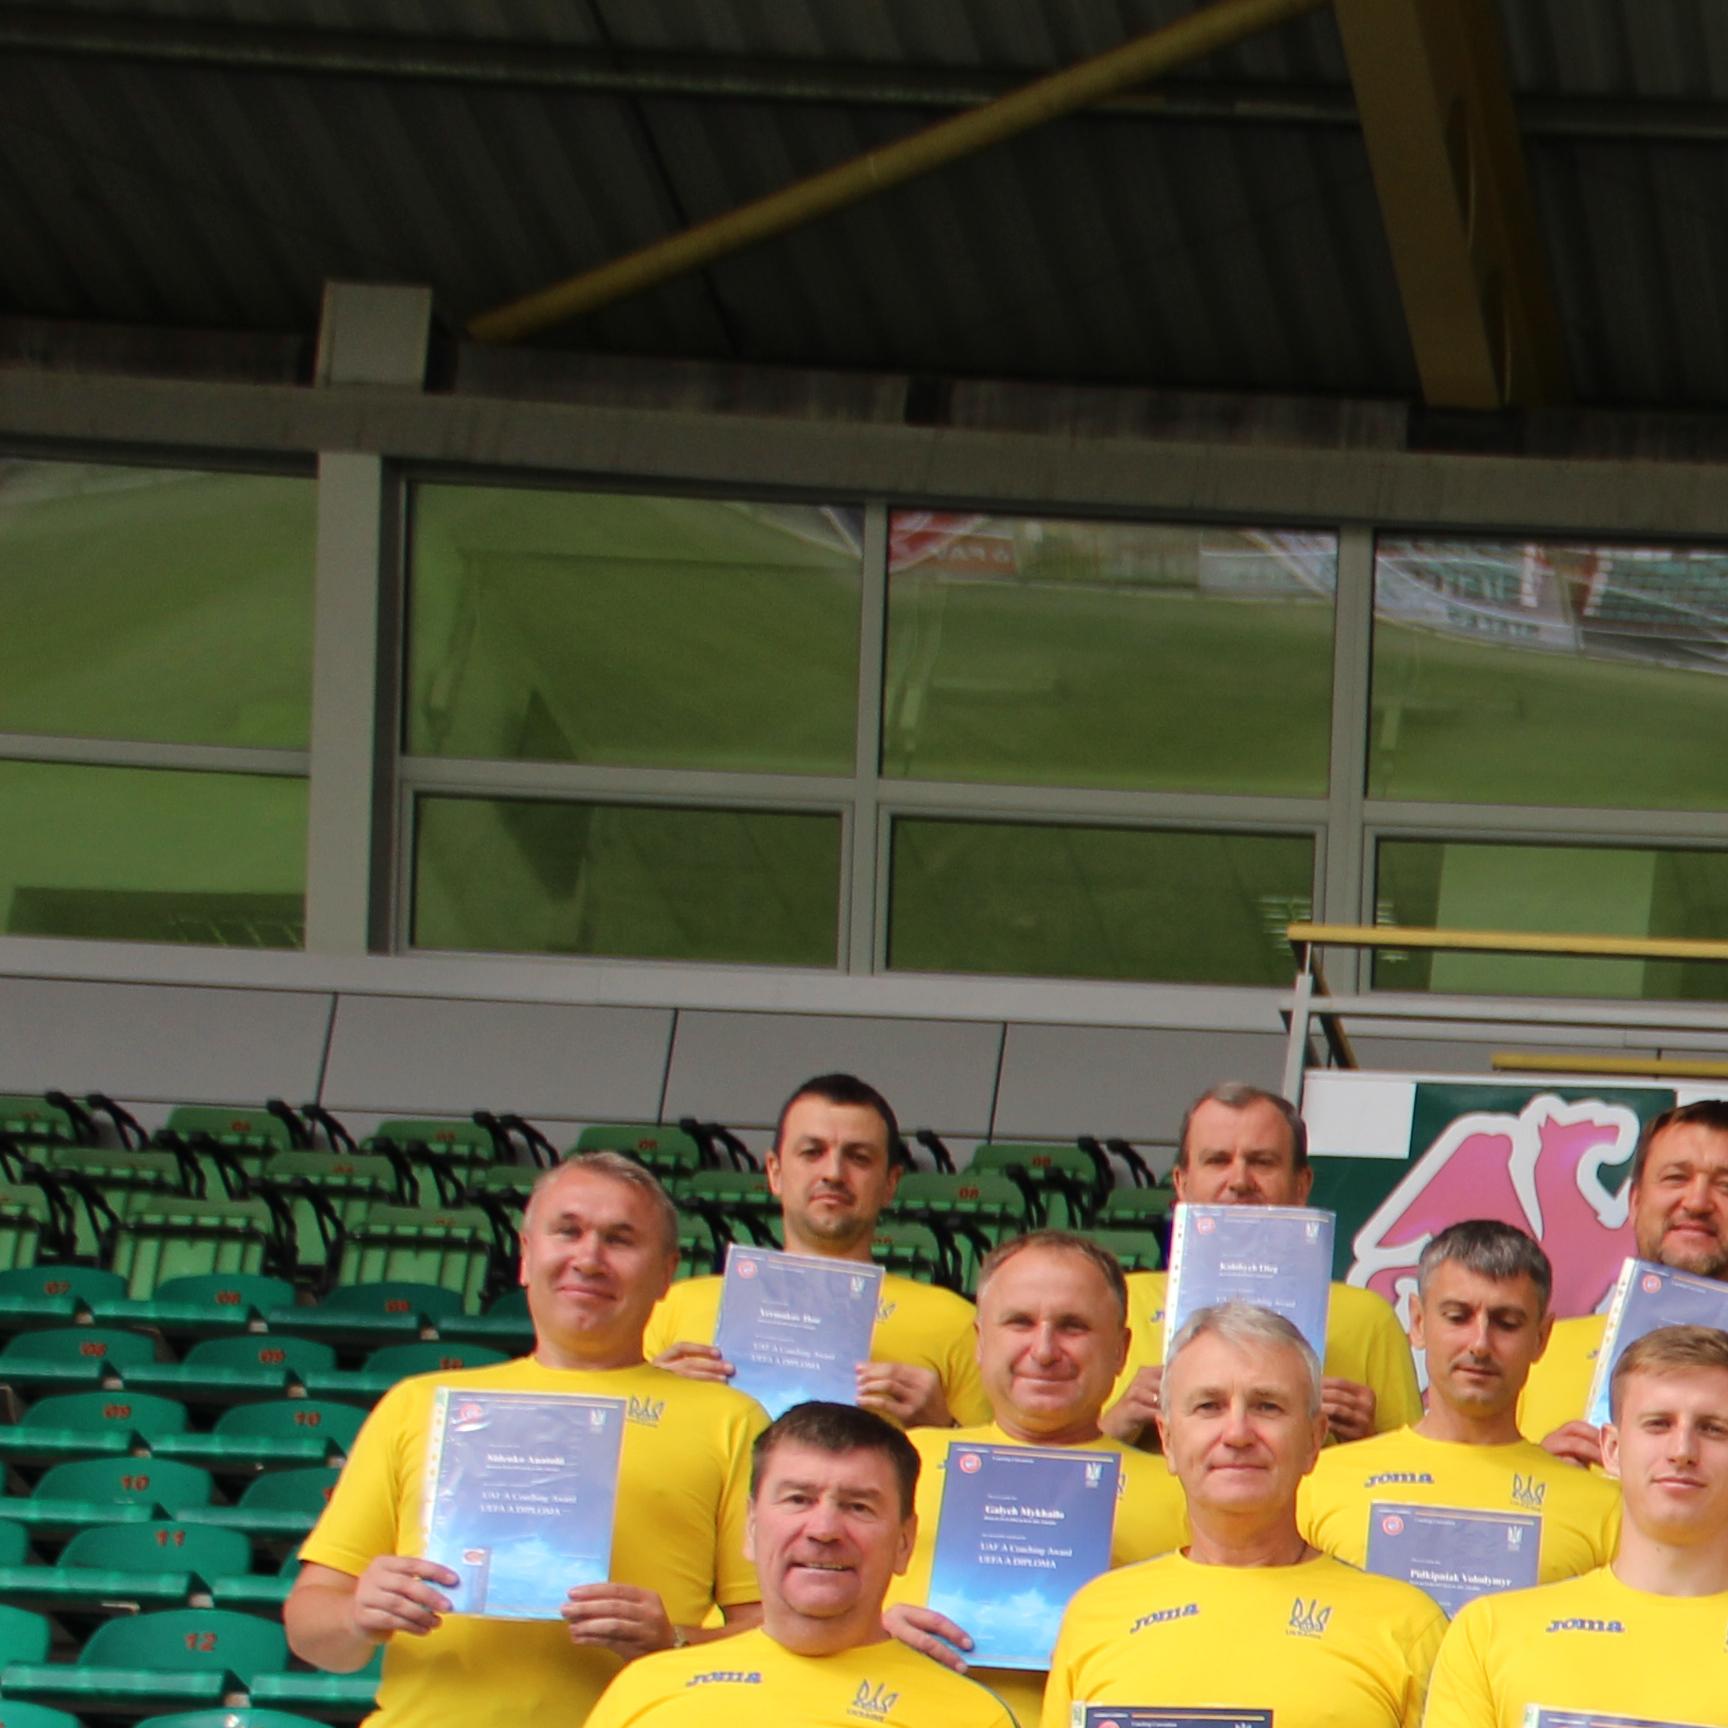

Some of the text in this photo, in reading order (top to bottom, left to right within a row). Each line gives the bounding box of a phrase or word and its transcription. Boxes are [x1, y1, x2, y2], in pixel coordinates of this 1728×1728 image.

[122, 1476, 150, 1491] 10
[155, 1531, 185, 1547] 11
[980, 1542, 1072, 1556] UAF A Coaching Award
[979, 1555, 1002, 1565] UEFA
[1013, 1558, 1057, 1568] DIPLOMA
[184, 1633, 217, 1652] 12
